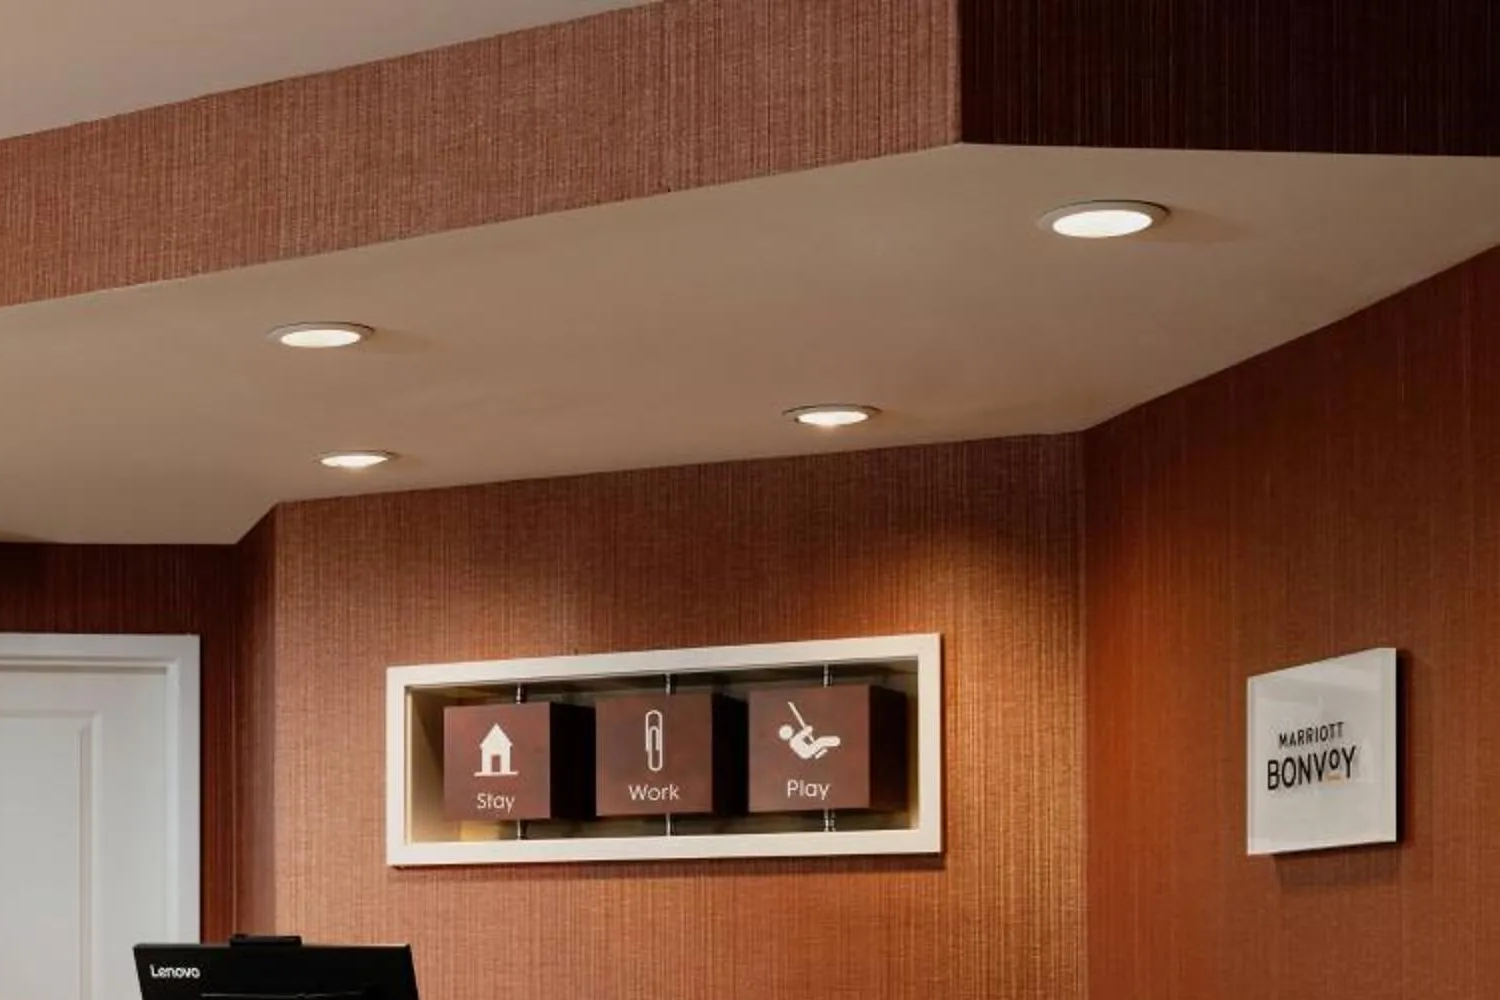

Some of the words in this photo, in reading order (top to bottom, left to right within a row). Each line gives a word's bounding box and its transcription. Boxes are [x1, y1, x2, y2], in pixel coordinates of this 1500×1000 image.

[1278, 721, 1345, 749] MARRIOTT
[627, 783, 681, 801] Work
[786, 778, 831, 801] Play
[476, 791, 516, 815] Stay
[148, 963, 201, 979] Lenovo
